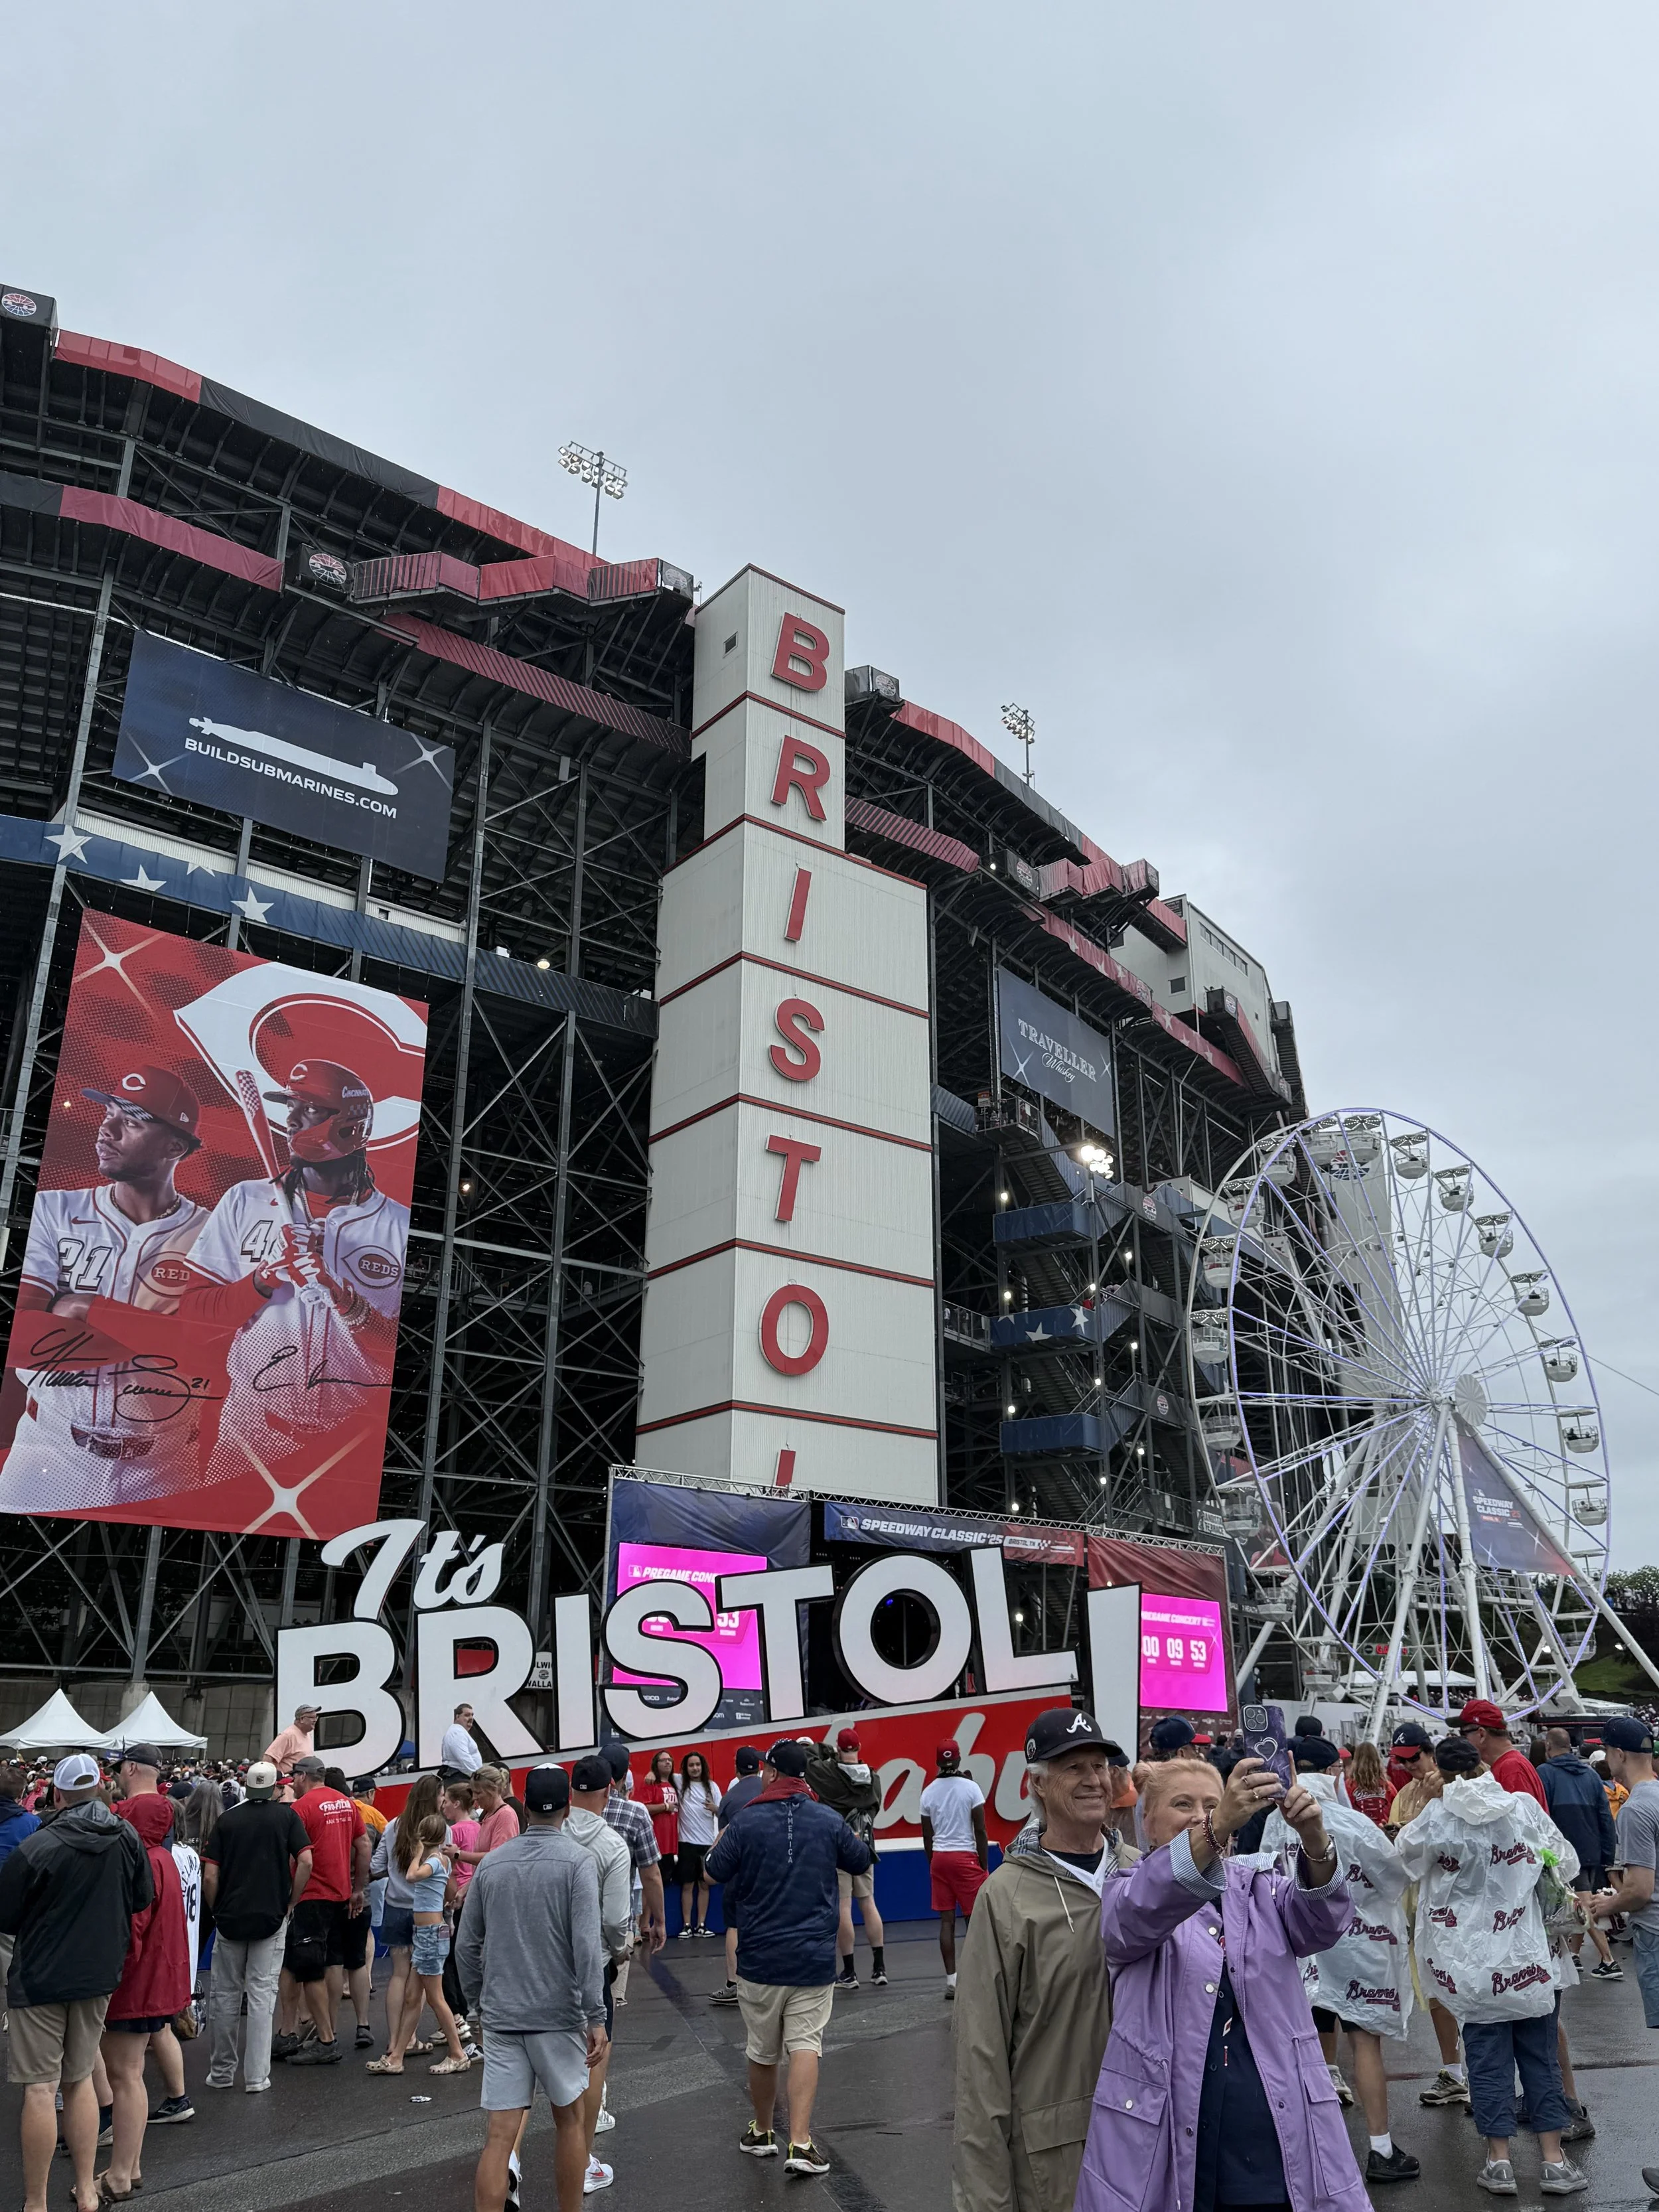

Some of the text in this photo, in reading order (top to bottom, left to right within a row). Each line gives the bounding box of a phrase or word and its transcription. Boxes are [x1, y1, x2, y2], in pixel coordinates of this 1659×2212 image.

[184, 737, 397, 819] BUILDSUBMARINES.COM
[1018, 1018, 1097, 1082] TRAVELLER
[1042, 1053, 1076, 1083] Whiskey
[58, 1238, 113, 1291] 21
[153, 1266, 190, 1281] RED
[360, 1259, 399, 1277] REDS
[1473, 1495, 1513, 1509] SPEEDWAY
[1477, 1505, 1510, 1517] CLASSIC
[860, 1518, 931, 1538] SPEEDWAY
[931, 1527, 987, 1544] CLASSIC
[321, 1518, 506, 1620] It's
[642, 1567, 691, 1582] PREGAME
[1167, 1637, 1183, 1659] 09
[1190, 1640, 1206, 1662] 53
[1066, 1713, 1092, 1733] A
